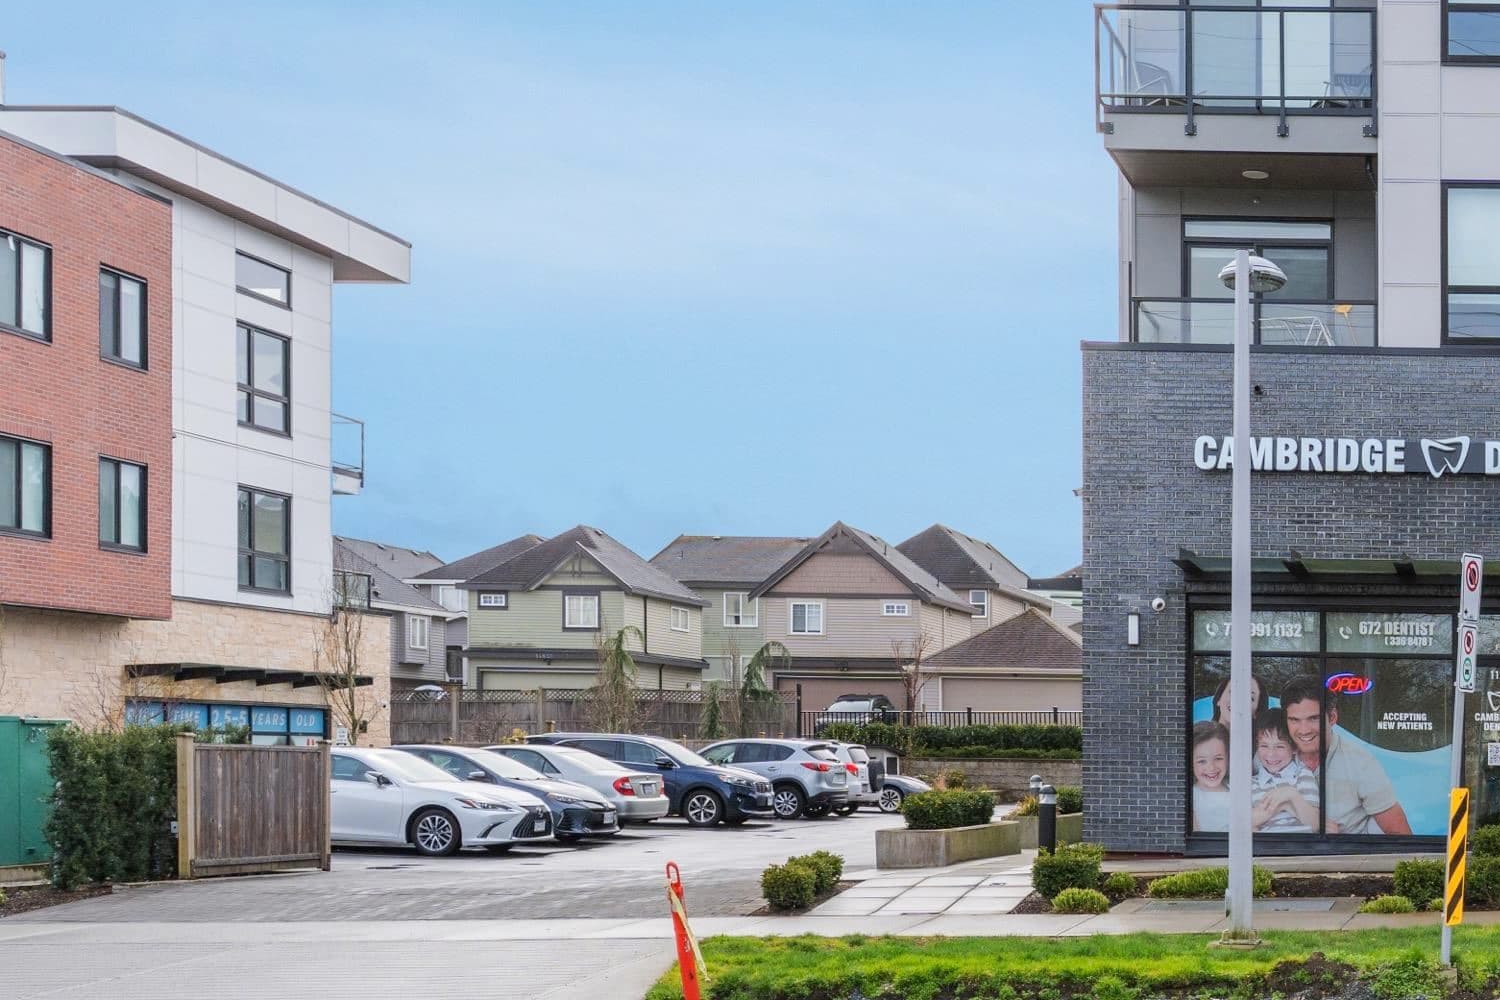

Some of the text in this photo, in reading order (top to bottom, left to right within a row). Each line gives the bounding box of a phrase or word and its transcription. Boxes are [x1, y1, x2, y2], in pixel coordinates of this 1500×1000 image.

[1194, 436, 1405, 473] CAMBRIDGE
[1273, 623, 1303, 638] 1132
[1359, 621, 1436, 636] 672 DENTIST
[1329, 677, 1369, 692] OPEN
[251, 712, 287, 726] YEARS
[296, 714, 316, 727] OLD
[1383, 712, 1427, 721] ACCEPTING
[1377, 720, 1433, 730] NEW PATIENTS
